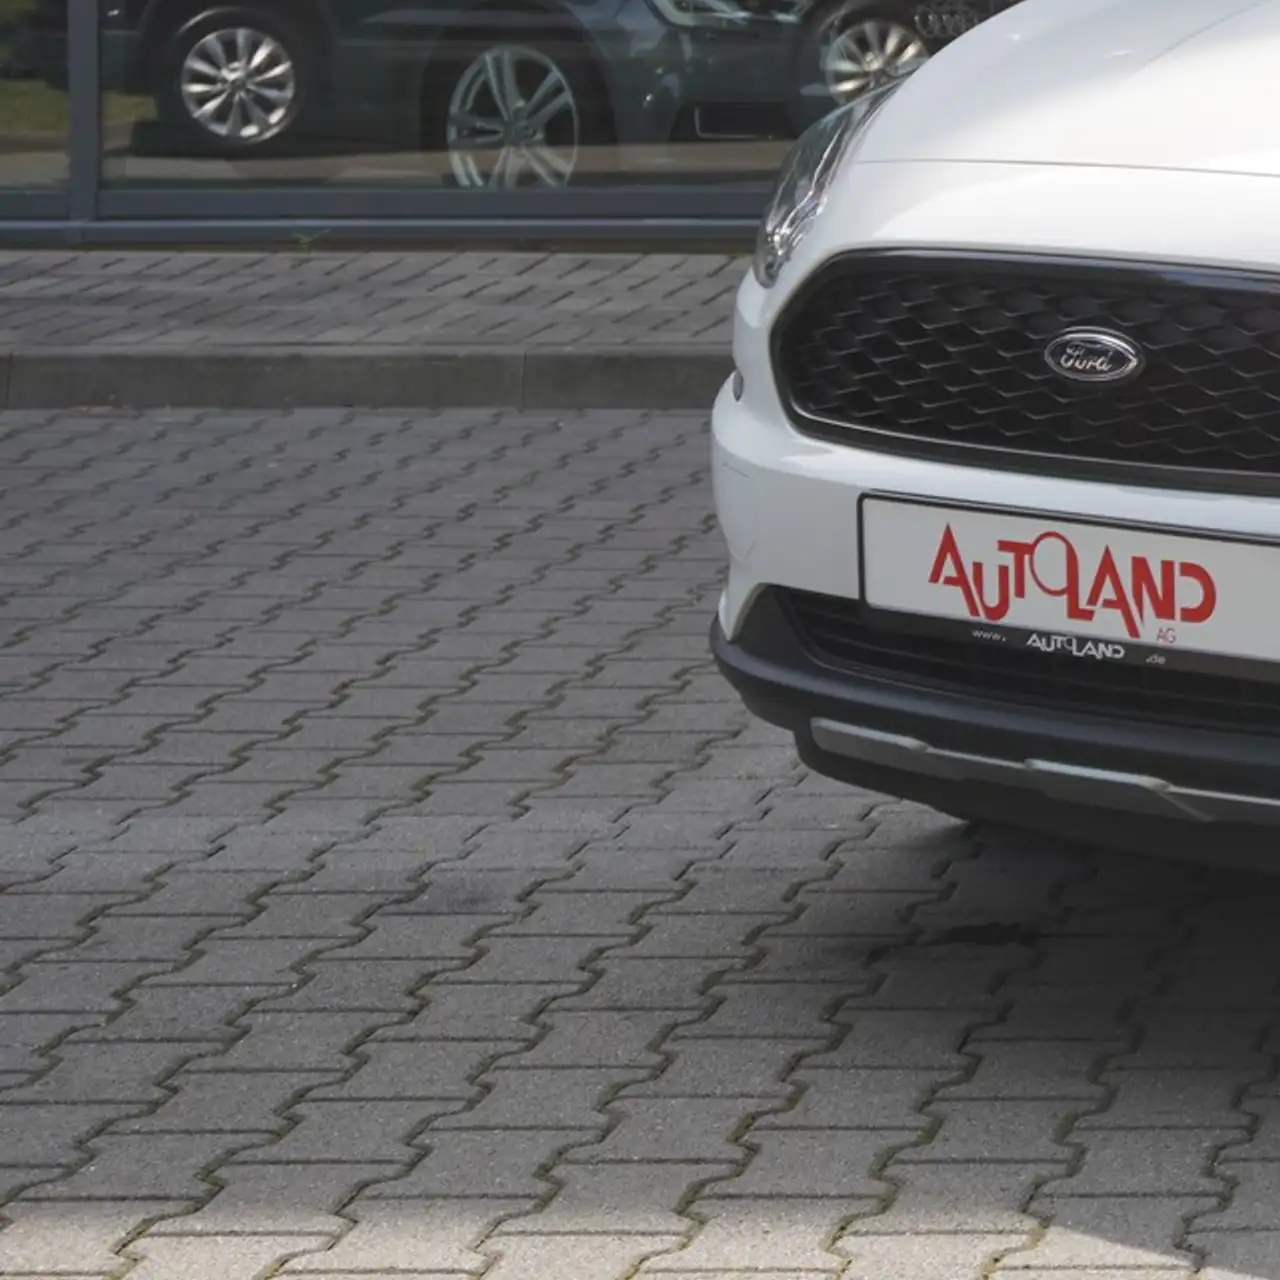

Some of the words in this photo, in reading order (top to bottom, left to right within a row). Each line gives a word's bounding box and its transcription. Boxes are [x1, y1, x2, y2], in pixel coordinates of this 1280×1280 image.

[1060, 340, 1114, 372] Ford
[928, 522, 1218, 639] AUTOLAND
[1026, 633, 1125, 660] AUTOLAND
[1156, 627, 1178, 644] AG
